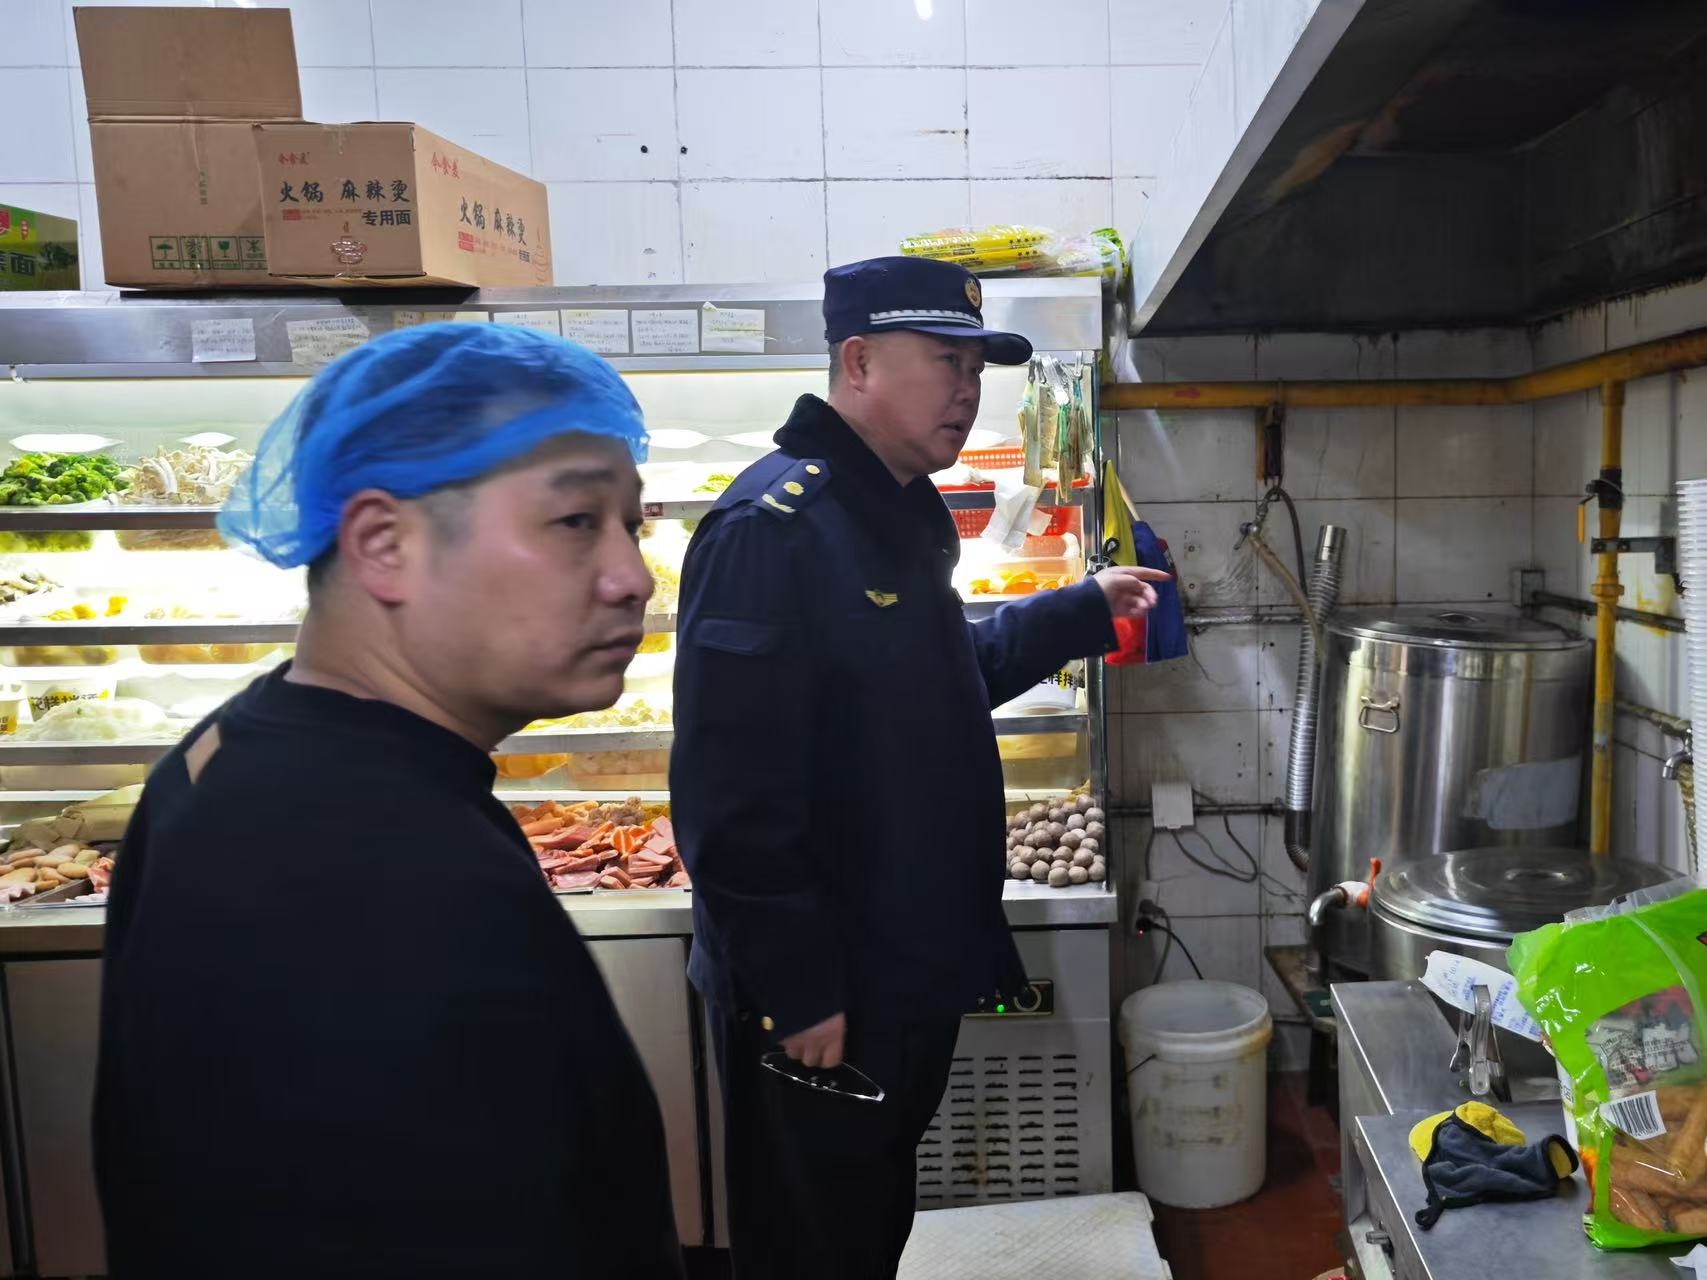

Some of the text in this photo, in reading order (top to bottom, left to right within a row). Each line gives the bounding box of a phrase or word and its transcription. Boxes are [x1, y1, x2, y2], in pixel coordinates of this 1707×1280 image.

[280, 179, 411, 203] 火锅 麻辣烫
[362, 209, 411, 226] 专用面
